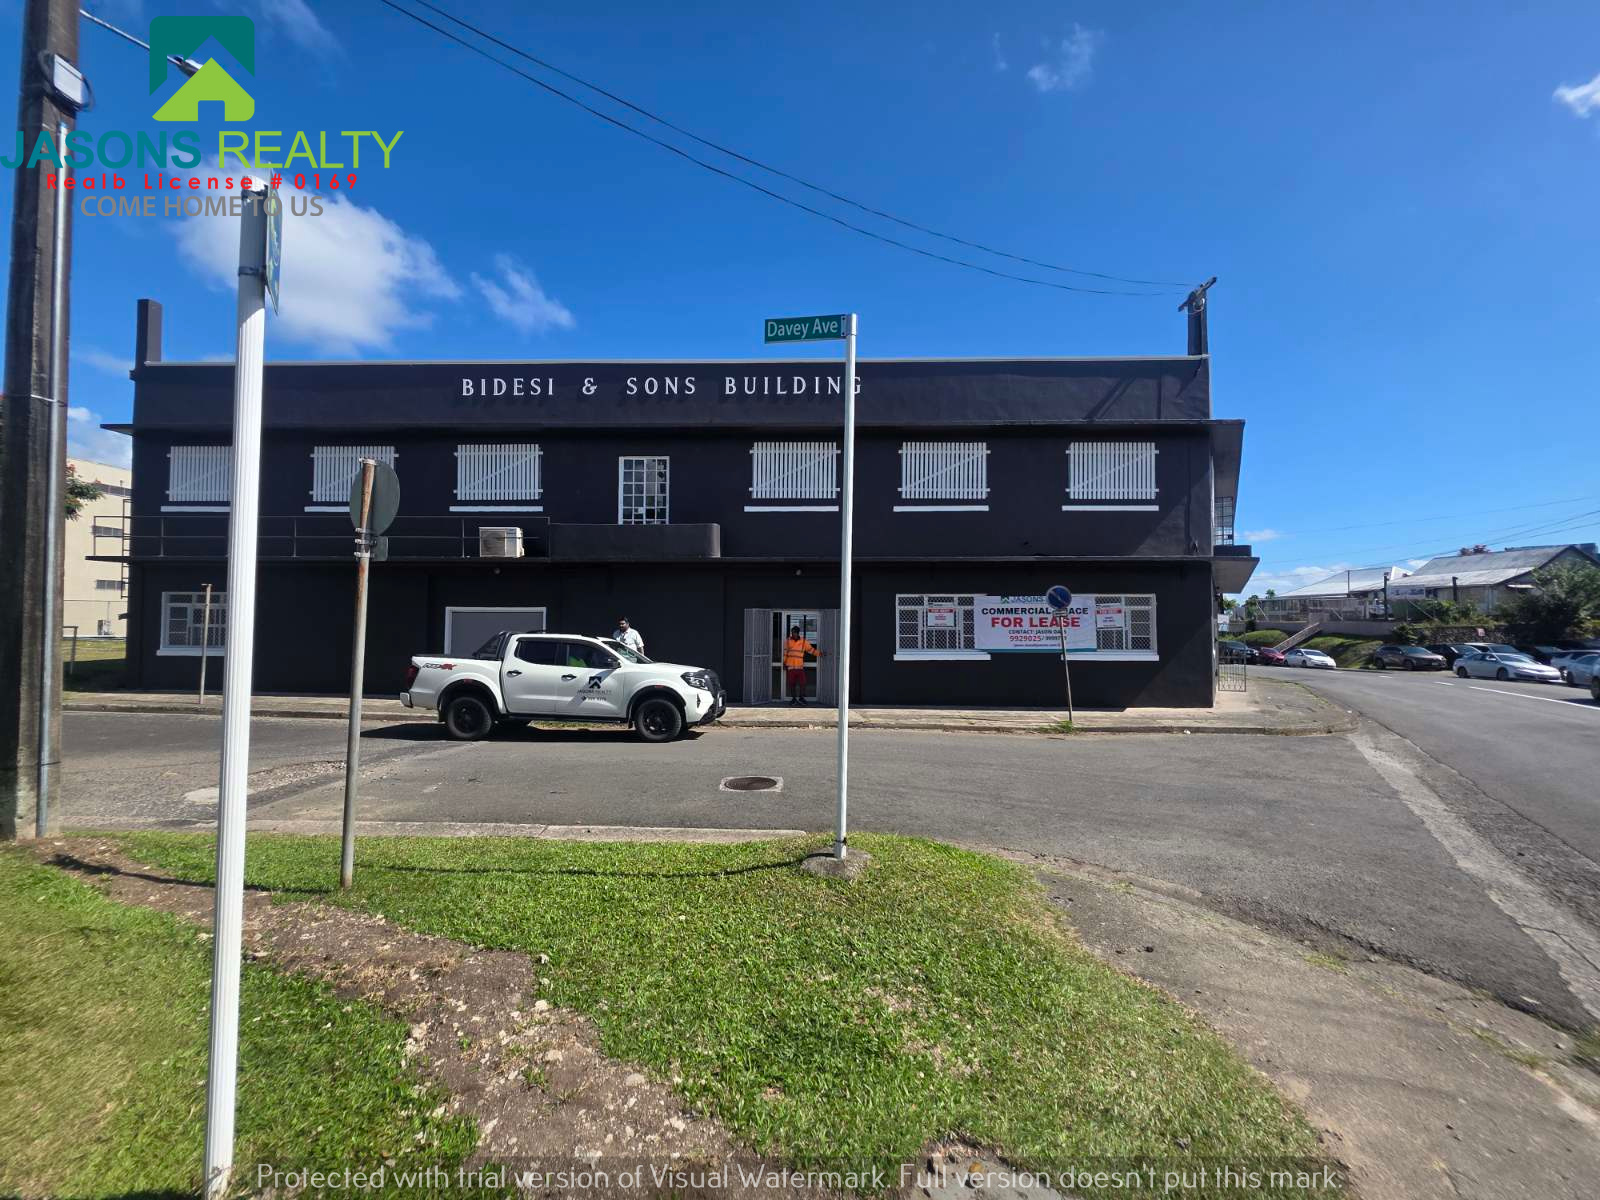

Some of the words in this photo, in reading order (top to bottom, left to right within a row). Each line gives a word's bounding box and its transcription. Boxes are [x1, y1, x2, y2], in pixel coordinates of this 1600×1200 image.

[767, 322, 809, 339] Davey
[812, 318, 838, 334] Ave
[462, 378, 554, 396] BIDESI
[582, 378, 598, 395] &
[626, 377, 696, 395] SONS
[725, 376, 862, 394] BUILDING
[981, 607, 1051, 615] COMMERCIAL
[991, 617, 1024, 628] FOR
[1029, 617, 1081, 628] LEASE
